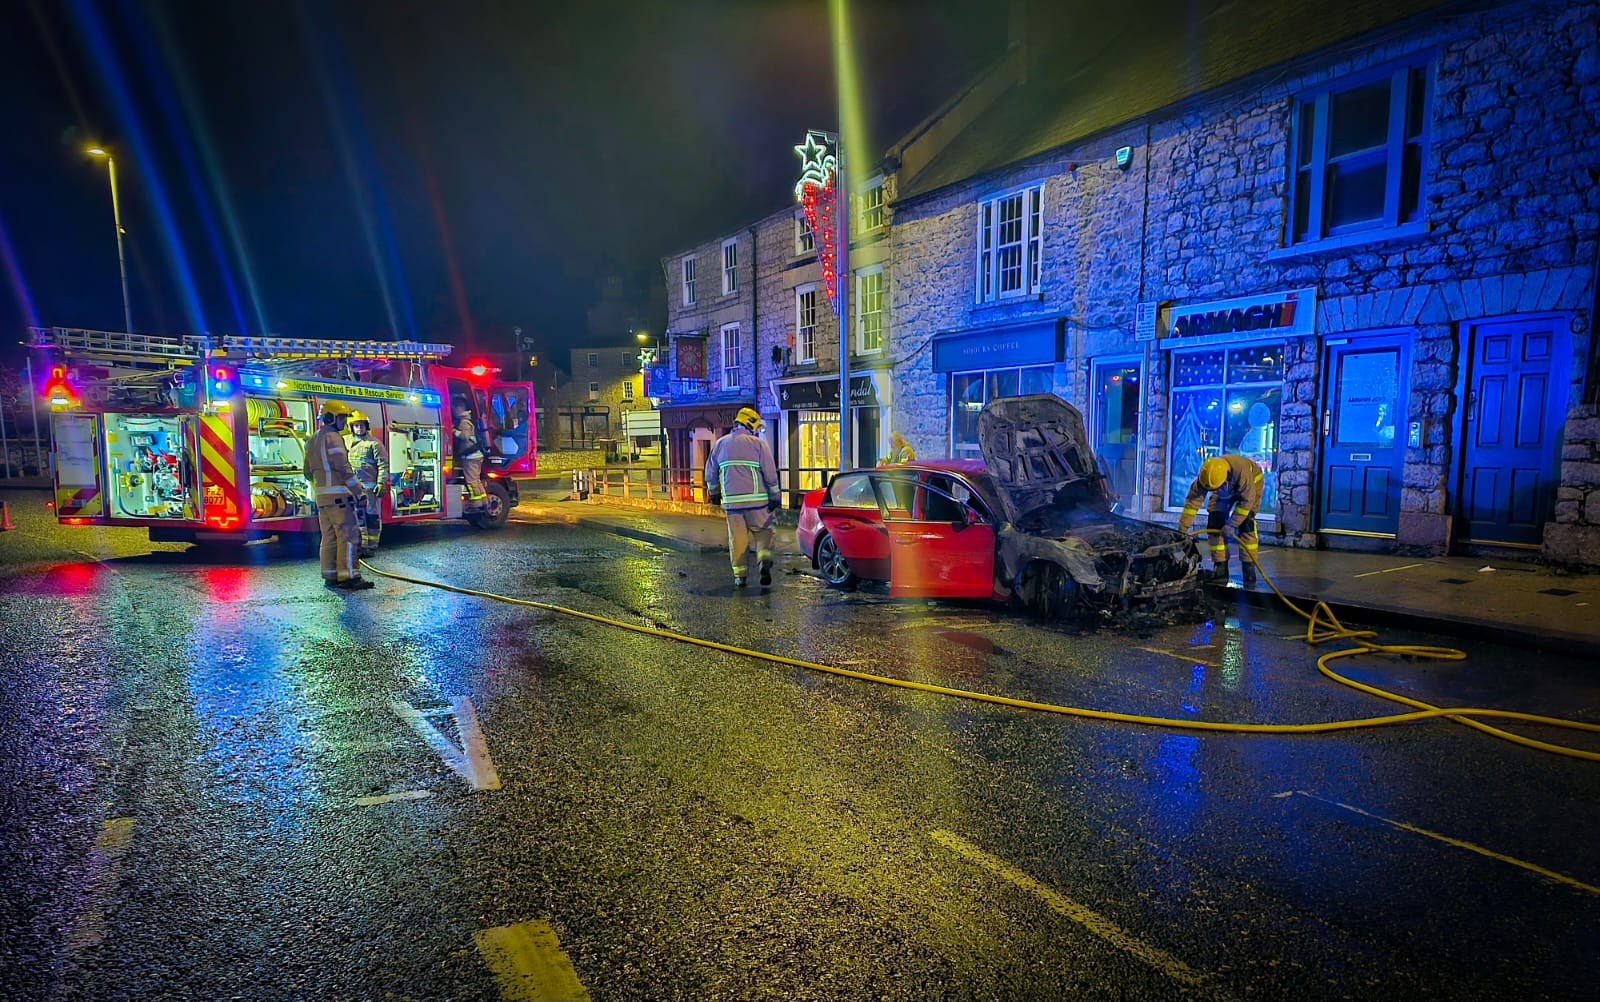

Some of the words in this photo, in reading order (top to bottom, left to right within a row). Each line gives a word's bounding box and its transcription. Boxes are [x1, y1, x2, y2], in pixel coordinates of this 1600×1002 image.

[294, 380, 322, 392] Northern
[323, 384, 344, 394] Ireland
[345, 386, 357, 395] Fire
[358, 387, 363, 396] &
[364, 388, 385, 398] Rescue
[386, 390, 405, 400] Service
[203, 495, 223, 504] 8077
